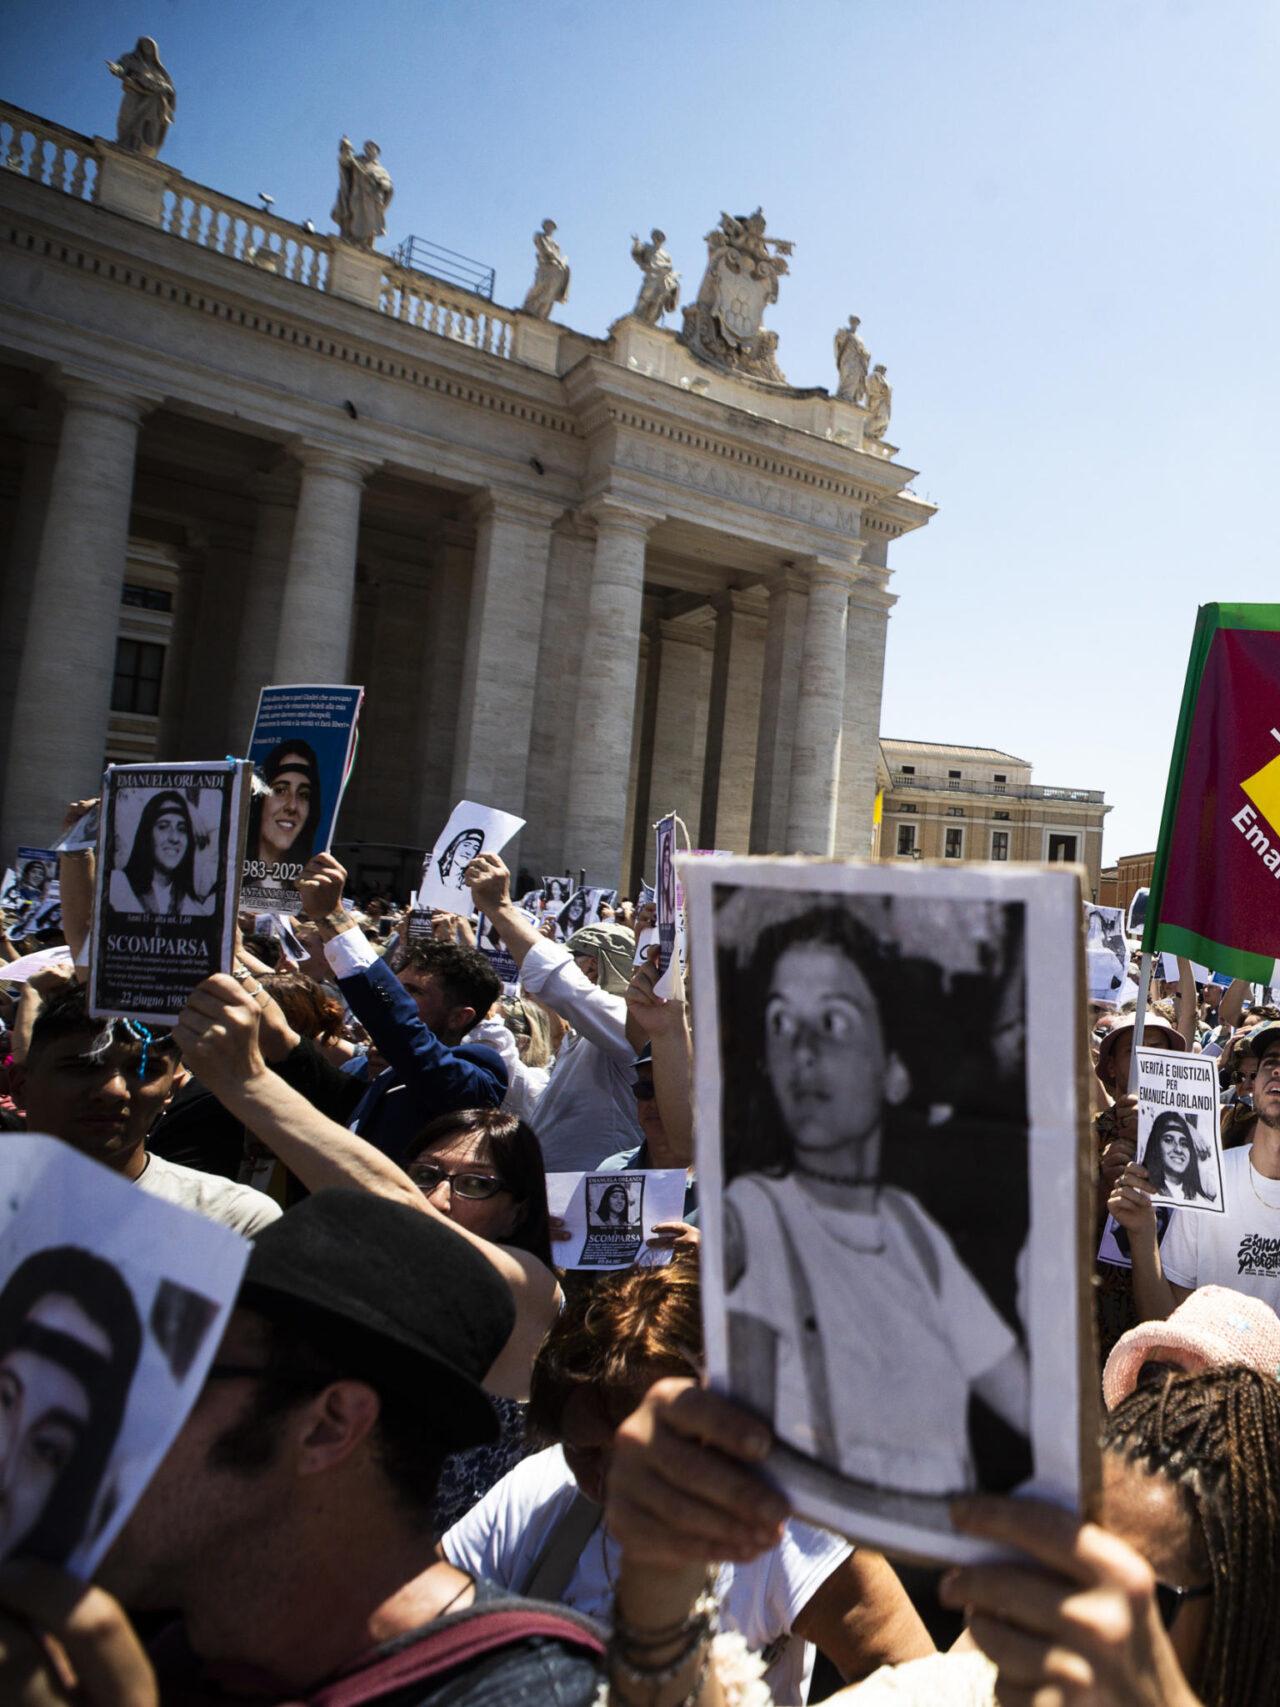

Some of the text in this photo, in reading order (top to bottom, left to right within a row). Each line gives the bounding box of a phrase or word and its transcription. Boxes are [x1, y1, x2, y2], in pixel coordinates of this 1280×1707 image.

[116, 773, 225, 788] EMANUELA ORLANDI
[106, 934, 209, 957] SCOMPARSA
[1140, 1060, 1211, 1082] VERITÀ E GIUSTIZIA
[1166, 1079, 1178, 1091] PER
[1140, 1086, 1213, 1112] EMANUELA ORLANDI
[588, 1233, 641, 1243] SCOMPARSA
